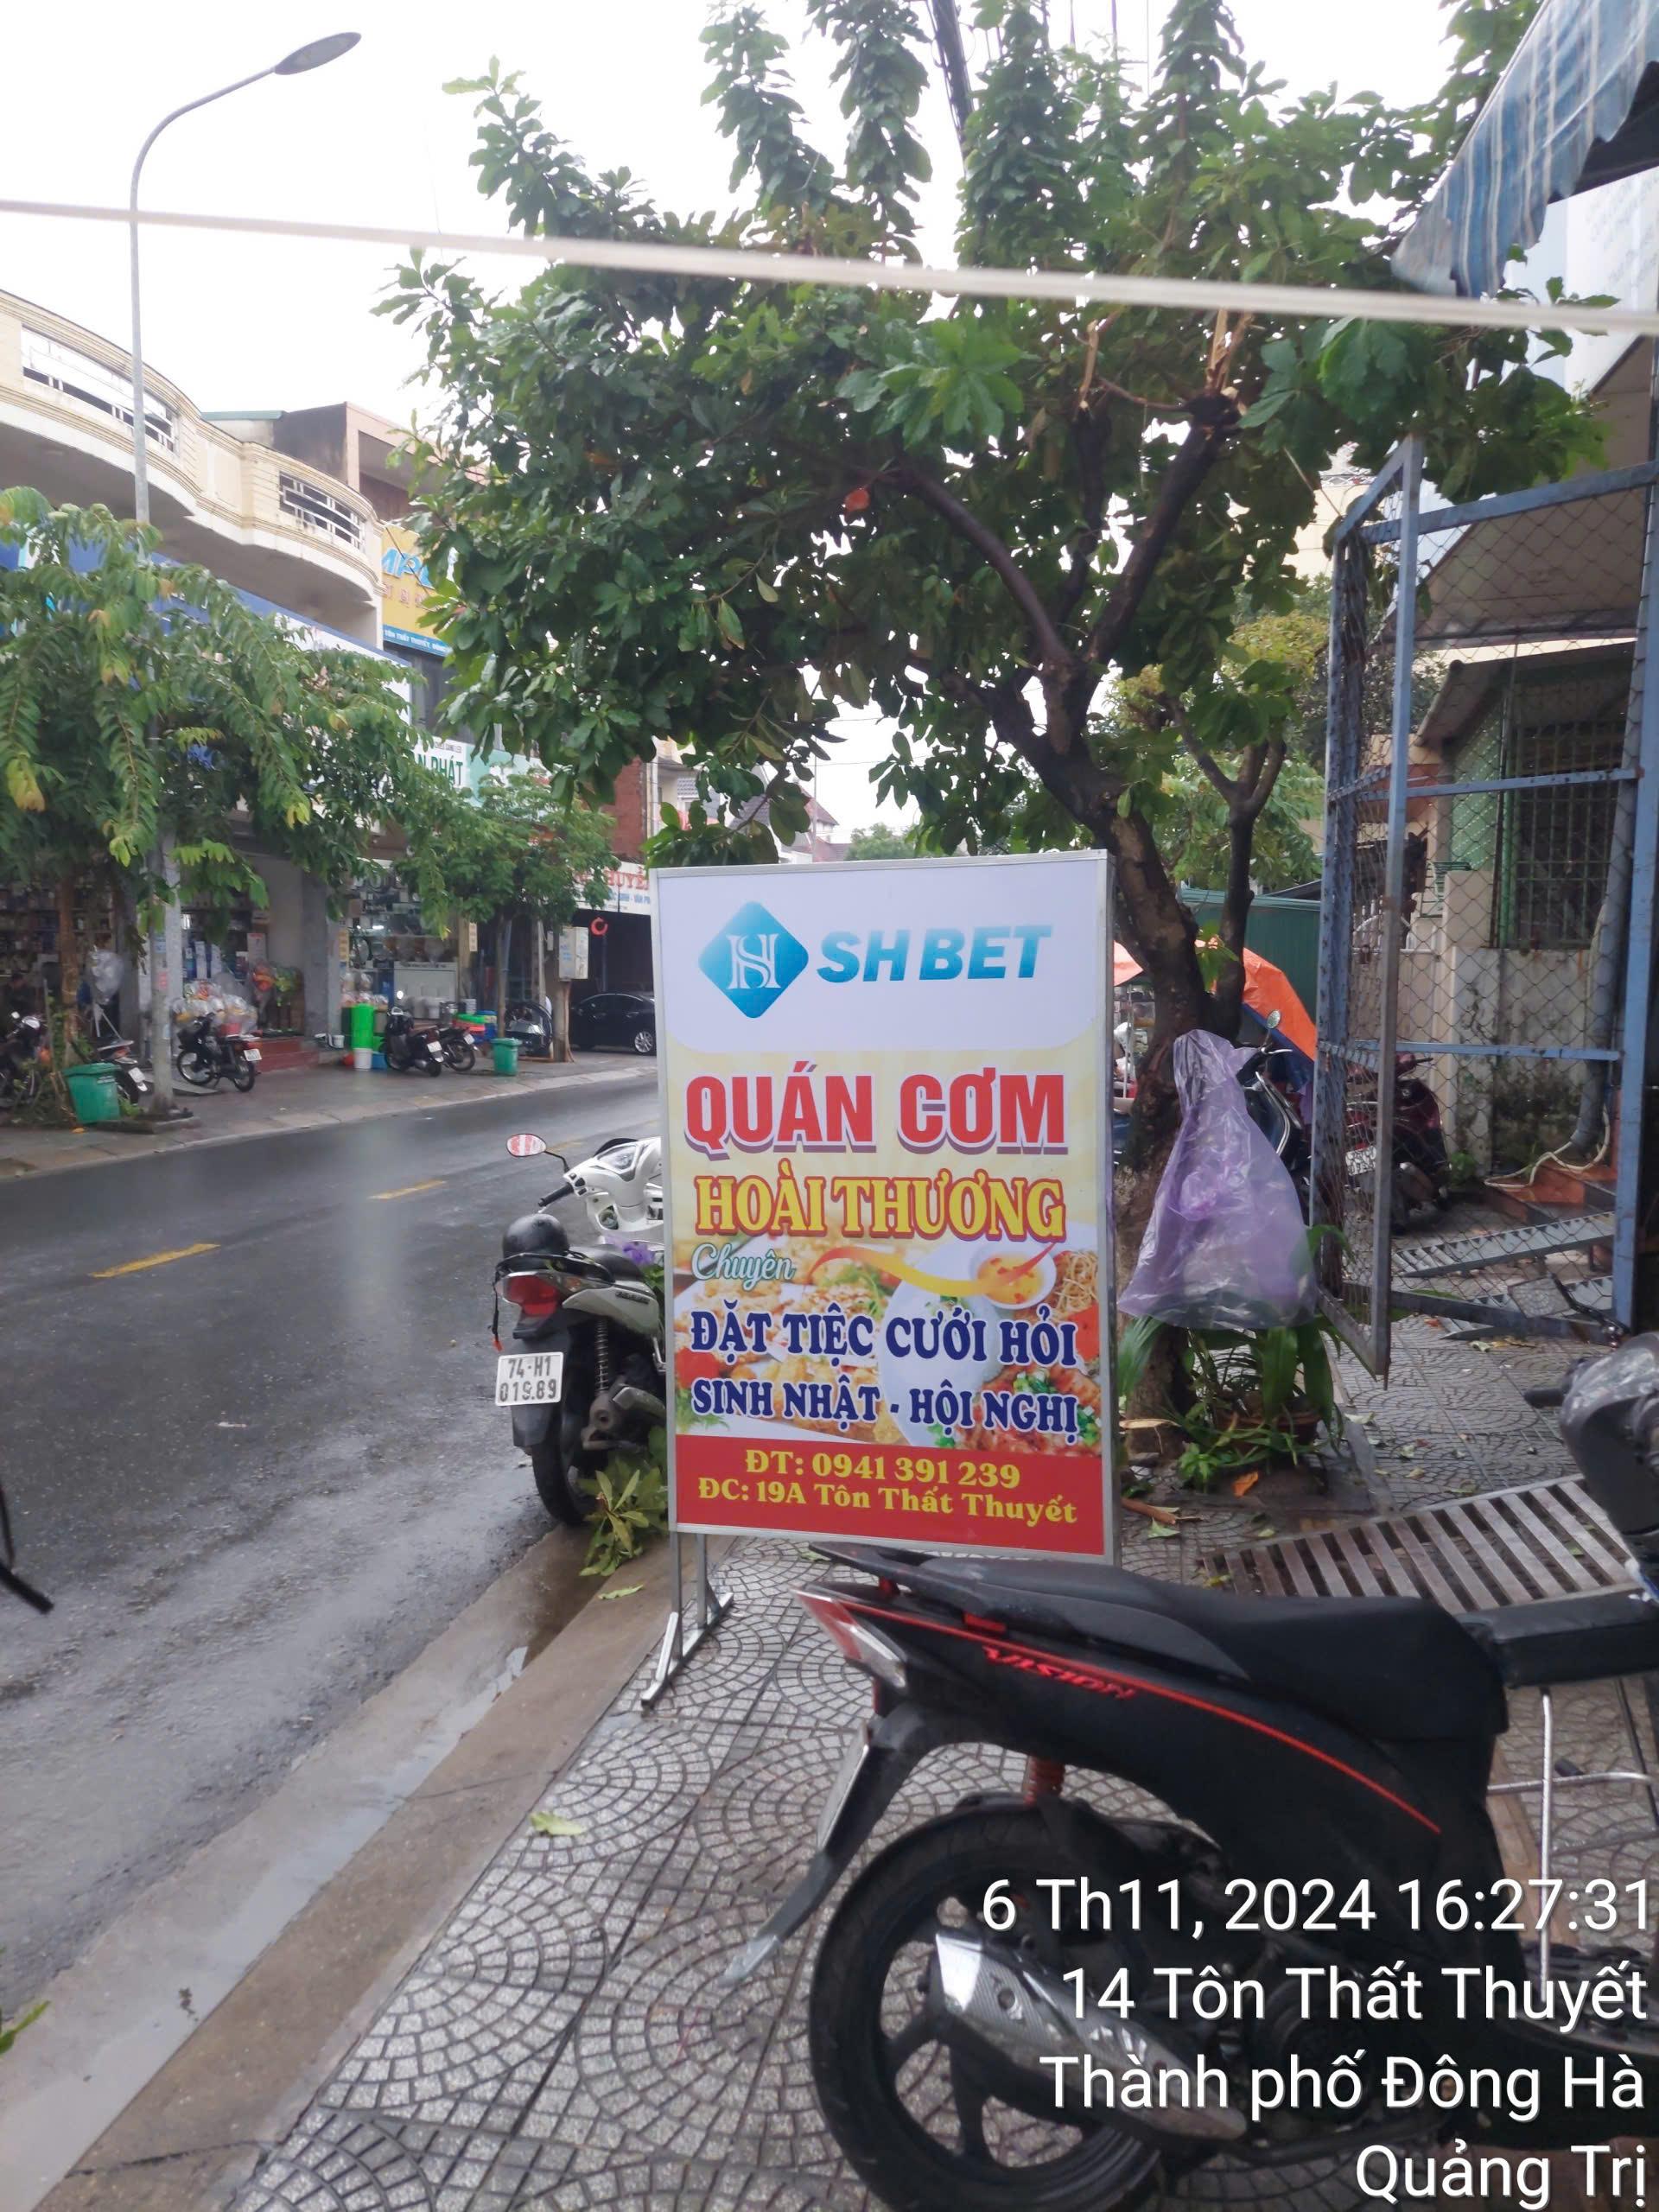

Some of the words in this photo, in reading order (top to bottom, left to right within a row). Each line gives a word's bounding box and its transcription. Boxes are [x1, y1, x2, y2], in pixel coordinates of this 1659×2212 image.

[685, 1061, 874, 1160] QUÁN
[899, 1067, 1066, 1154] CƠM
[694, 1159, 825, 1237] HOÀI
[830, 1169, 1066, 1241] THƯƠNG
[691, 1243, 796, 1291] Chuyên
[690, 1299, 771, 1363] ĐẶT
[782, 1302, 874, 1367] TIỆC
[886, 1307, 988, 1362] CƯỚI
[999, 1306, 1077, 1367] HỎI
[692, 1378, 772, 1417] SINH
[783, 1374, 880, 1430] NHẬT
[909, 1379, 973, 1435] HỘI
[983, 1390, 1077, 1444] NGHỊ
[698, 1477, 749, 1502] ĐC:
[757, 1480, 807, 1505] 19A
[814, 1482, 871, 1510] Tôn
[878, 1485, 955, 1514] Thất
[962, 1492, 1077, 1527] Thuyết
[745, 1449, 804, 1476] ĐT:
[812, 1452, 887, 1481] 0941
[896, 1458, 950, 1485] 391
[958, 1461, 1020, 1489] 239
